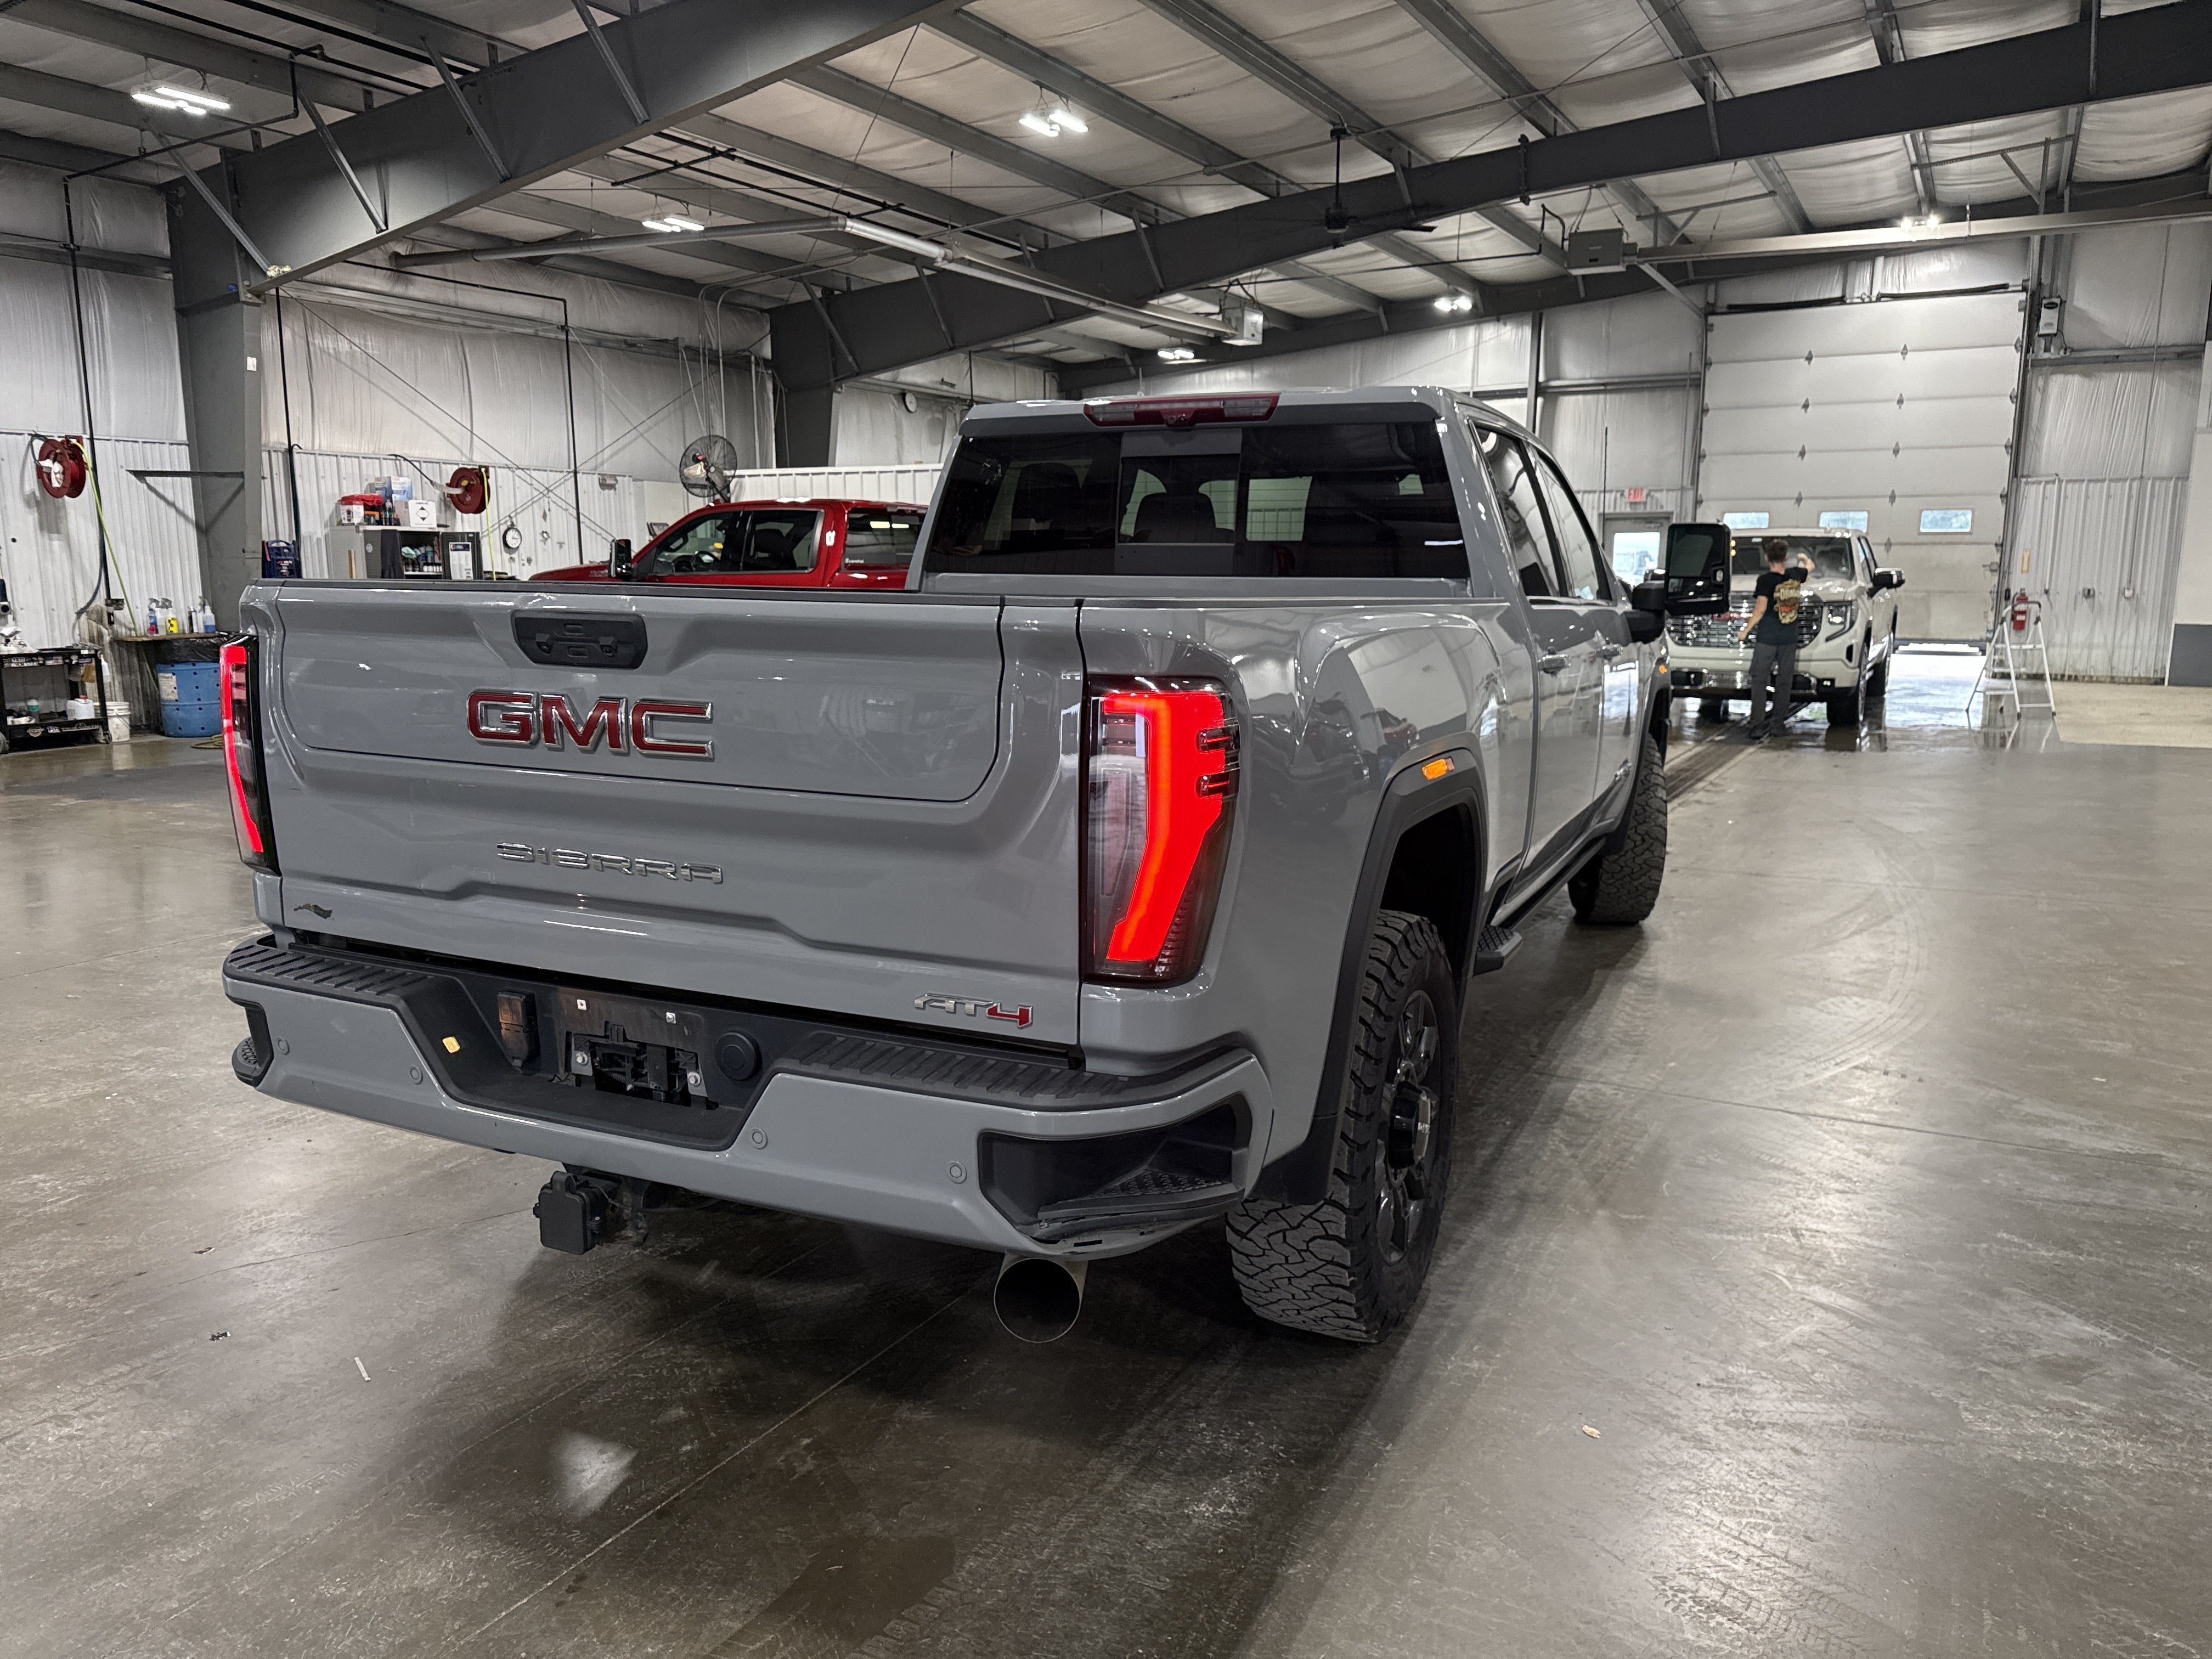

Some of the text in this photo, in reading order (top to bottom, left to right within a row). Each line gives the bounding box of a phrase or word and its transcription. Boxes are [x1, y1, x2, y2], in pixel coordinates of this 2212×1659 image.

[1628, 487, 1644, 501] EXIT
[467, 689, 714, 759] GMC
[496, 842, 724, 884] SIERRA
[914, 988, 1032, 1028] AT4
